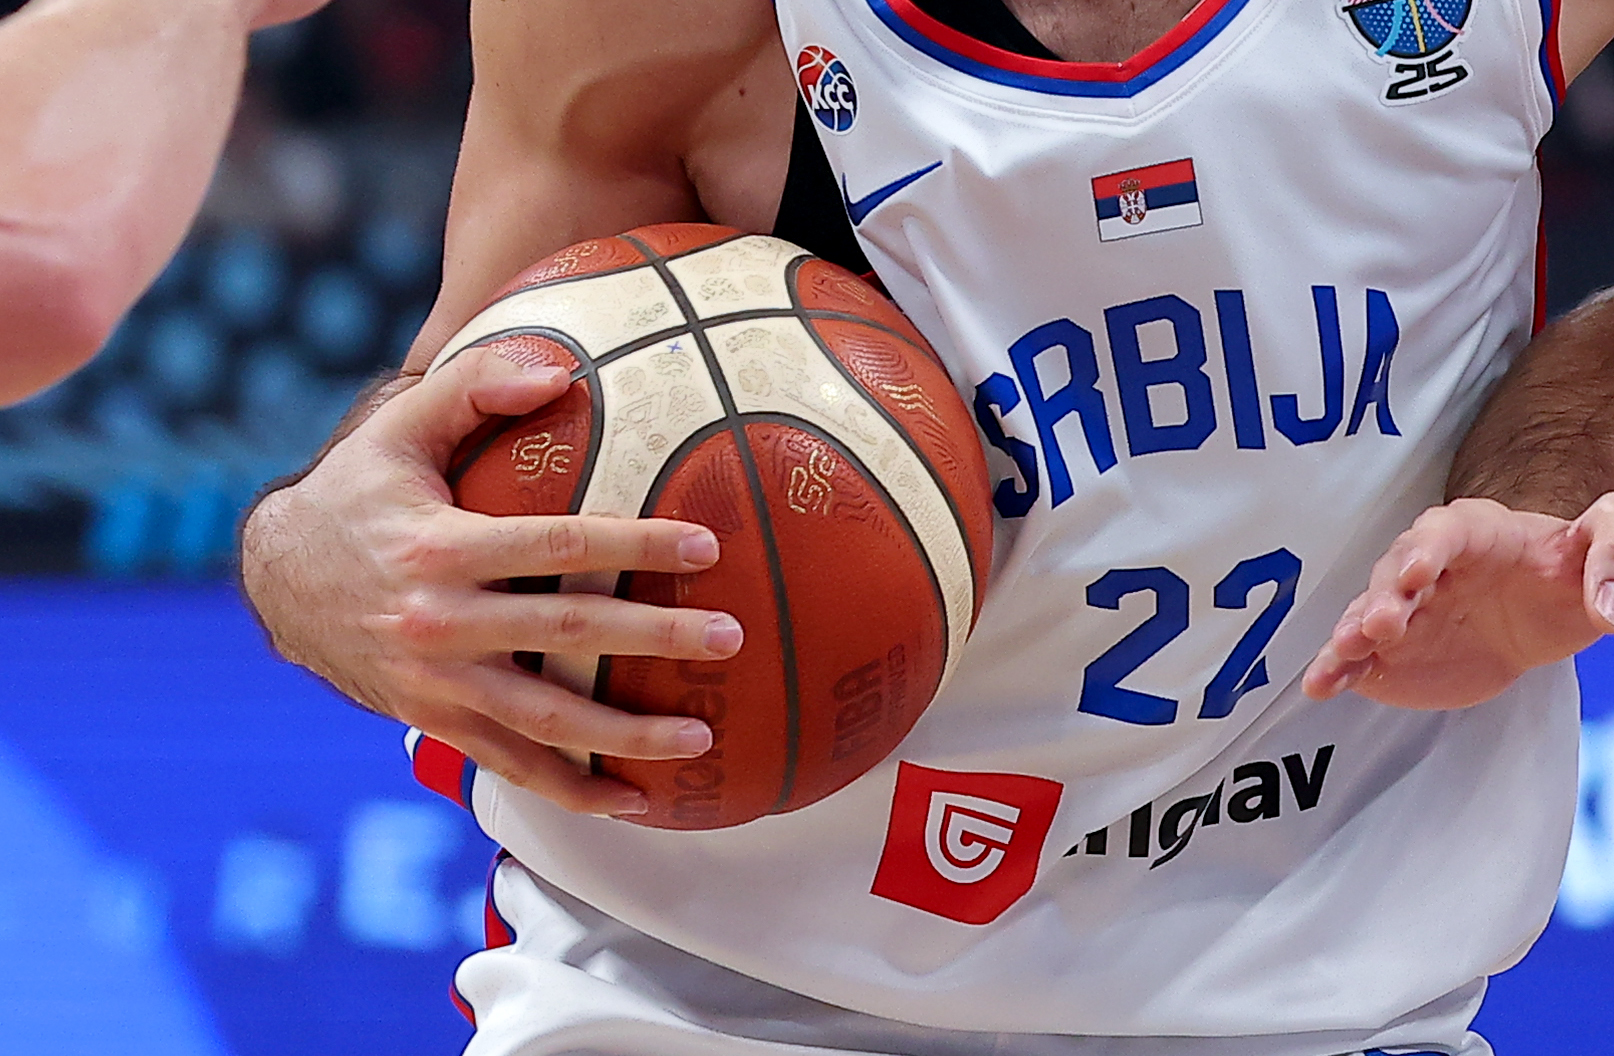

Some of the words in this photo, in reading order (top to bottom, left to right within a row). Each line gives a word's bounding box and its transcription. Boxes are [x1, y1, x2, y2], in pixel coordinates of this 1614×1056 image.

[1386, 50, 1469, 100] 25
[974, 285, 1403, 519] SRBIJA
[1077, 546, 1304, 725] 22
